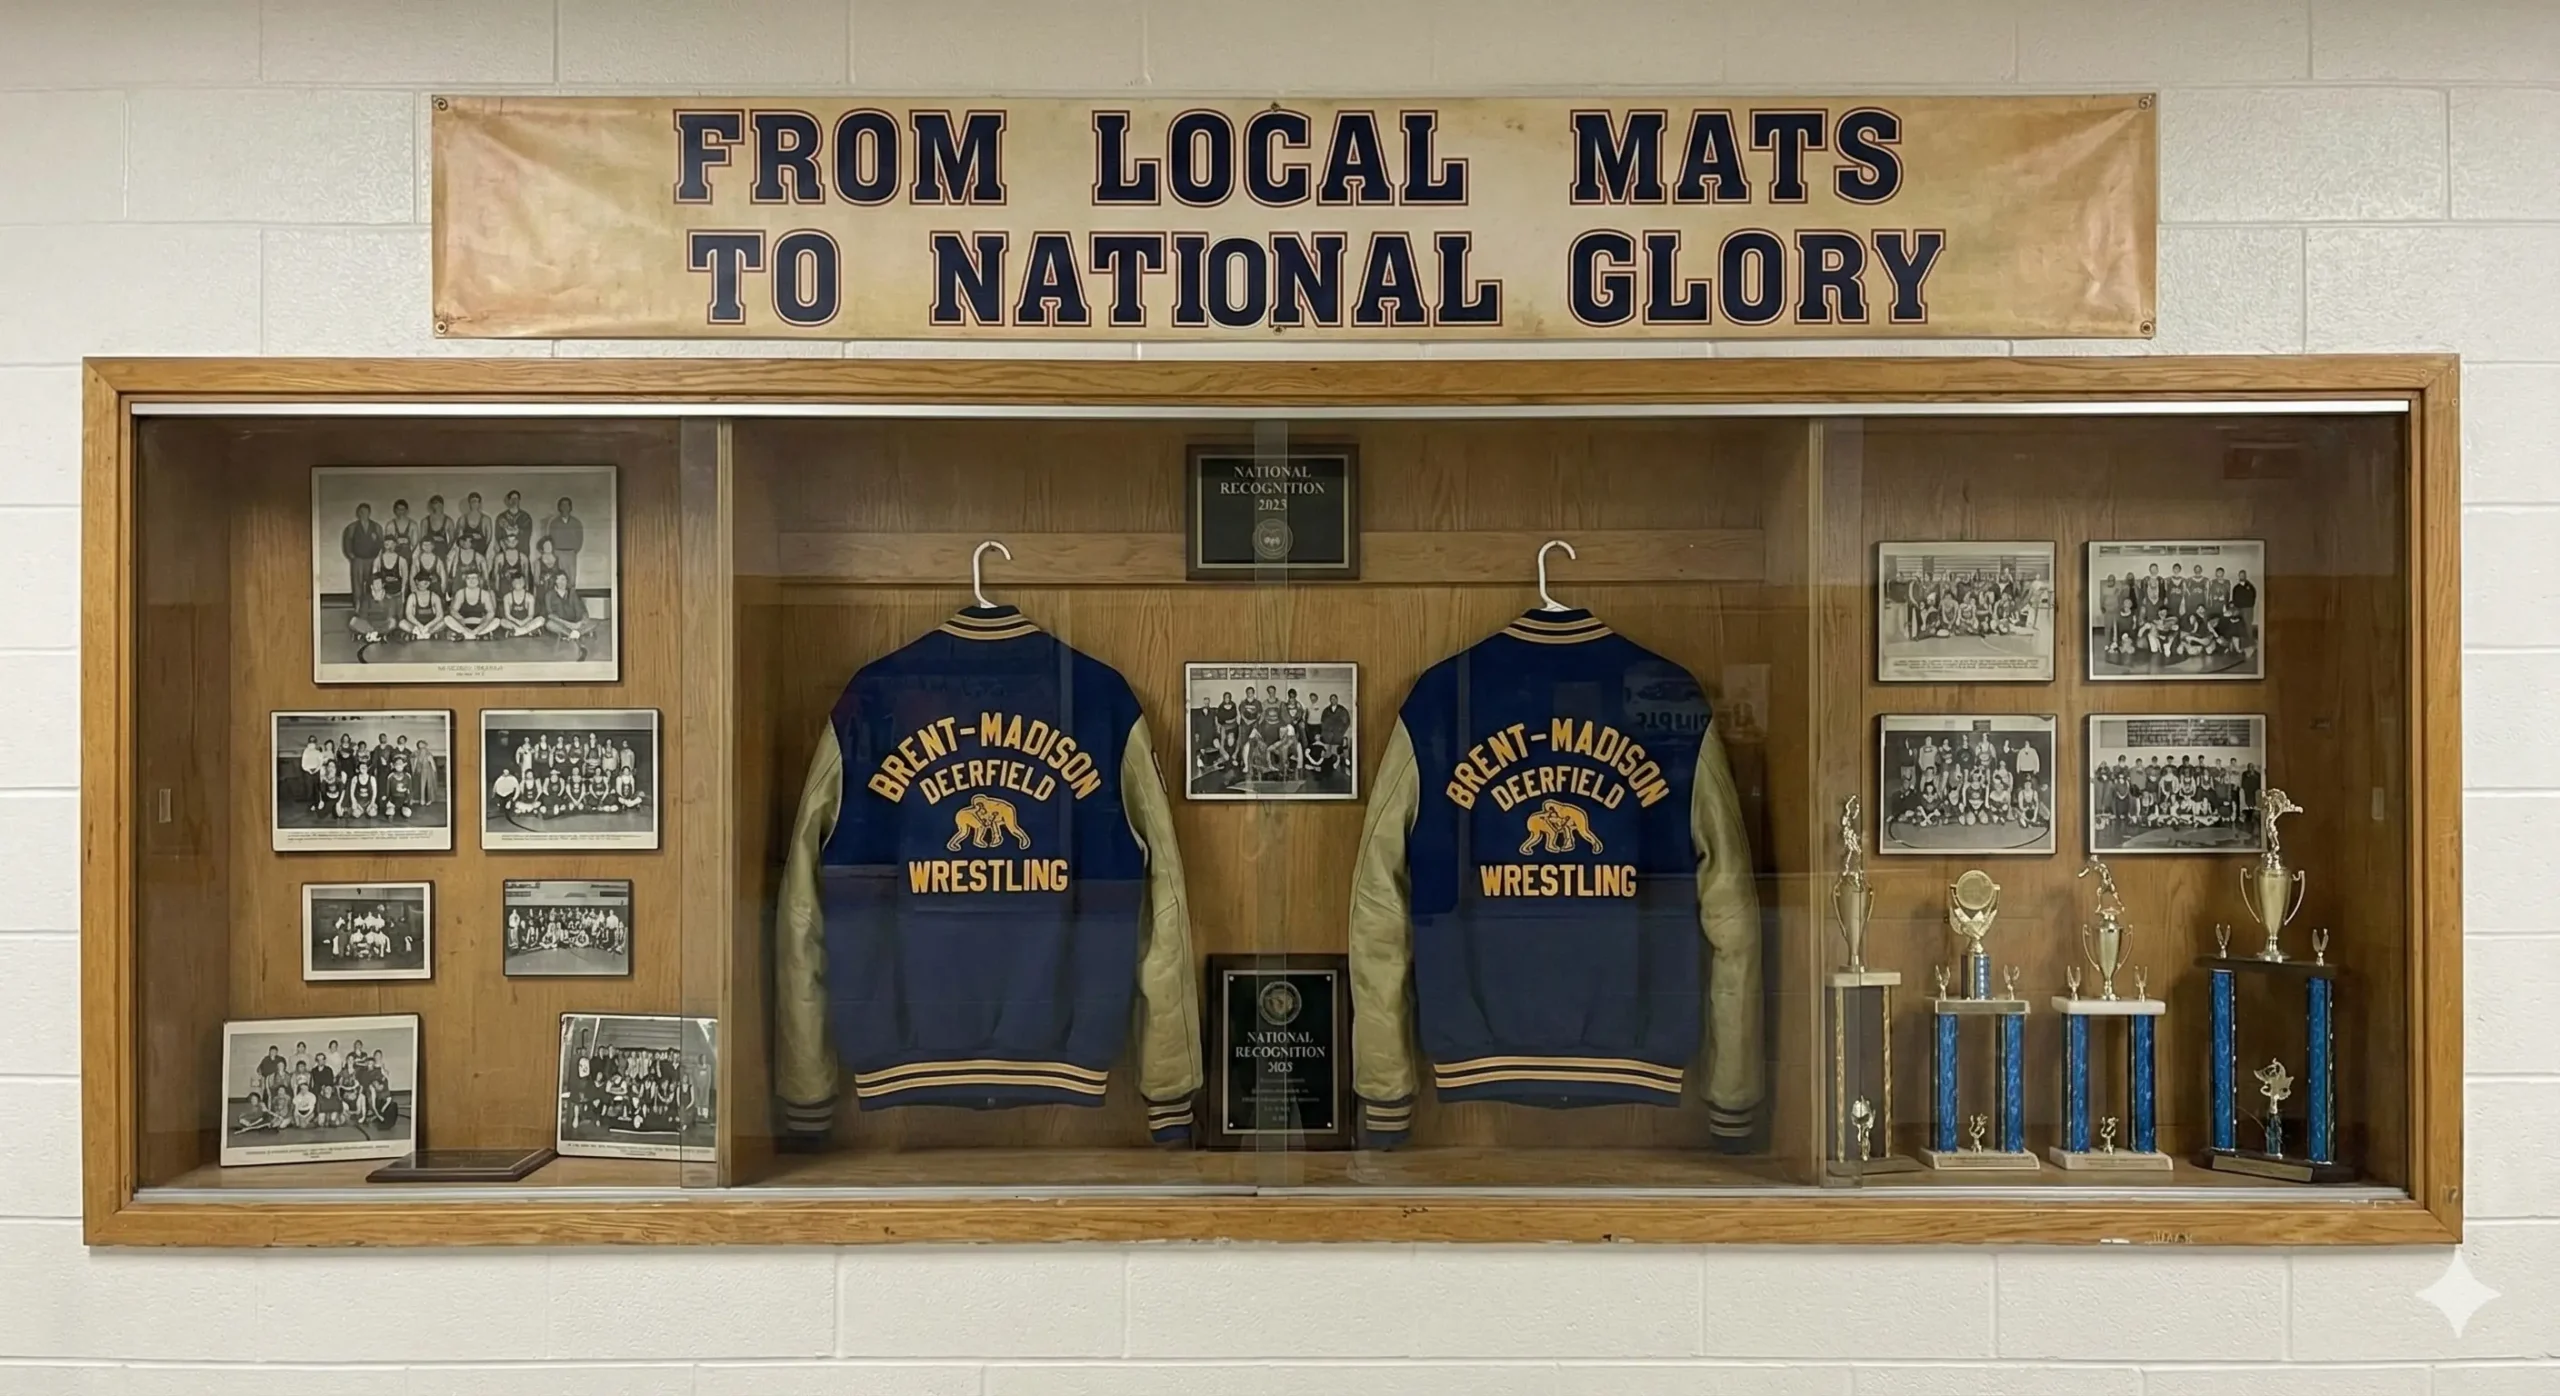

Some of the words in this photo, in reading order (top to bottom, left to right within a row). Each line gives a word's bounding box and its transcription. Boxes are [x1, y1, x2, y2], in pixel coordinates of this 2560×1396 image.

[673, 109, 1006, 206] FROM
[1092, 109, 1469, 207] LOCAL
[1570, 107, 1905, 206] MATS
[687, 229, 841, 327] TO
[929, 229, 1503, 328] NATIONAL
[1568, 228, 1946, 327] GLORY
[1219, 482, 1326, 495] RECOGNITION
[1234, 466, 1312, 478] NATIONAL
[867, 711, 1101, 803] BRENT-MADISON
[1446, 717, 1670, 810] BRENT-MADISON
[919, 759, 1056, 805] DEERFIELD
[1491, 765, 1625, 812] DEERFIELD
[908, 859, 1069, 894] WRESTLING
[1480, 864, 1637, 897] WRESTLING
[1235, 1046, 1326, 1058] RECOGNITION
[1247, 1031, 1314, 1044] NATIONAL
